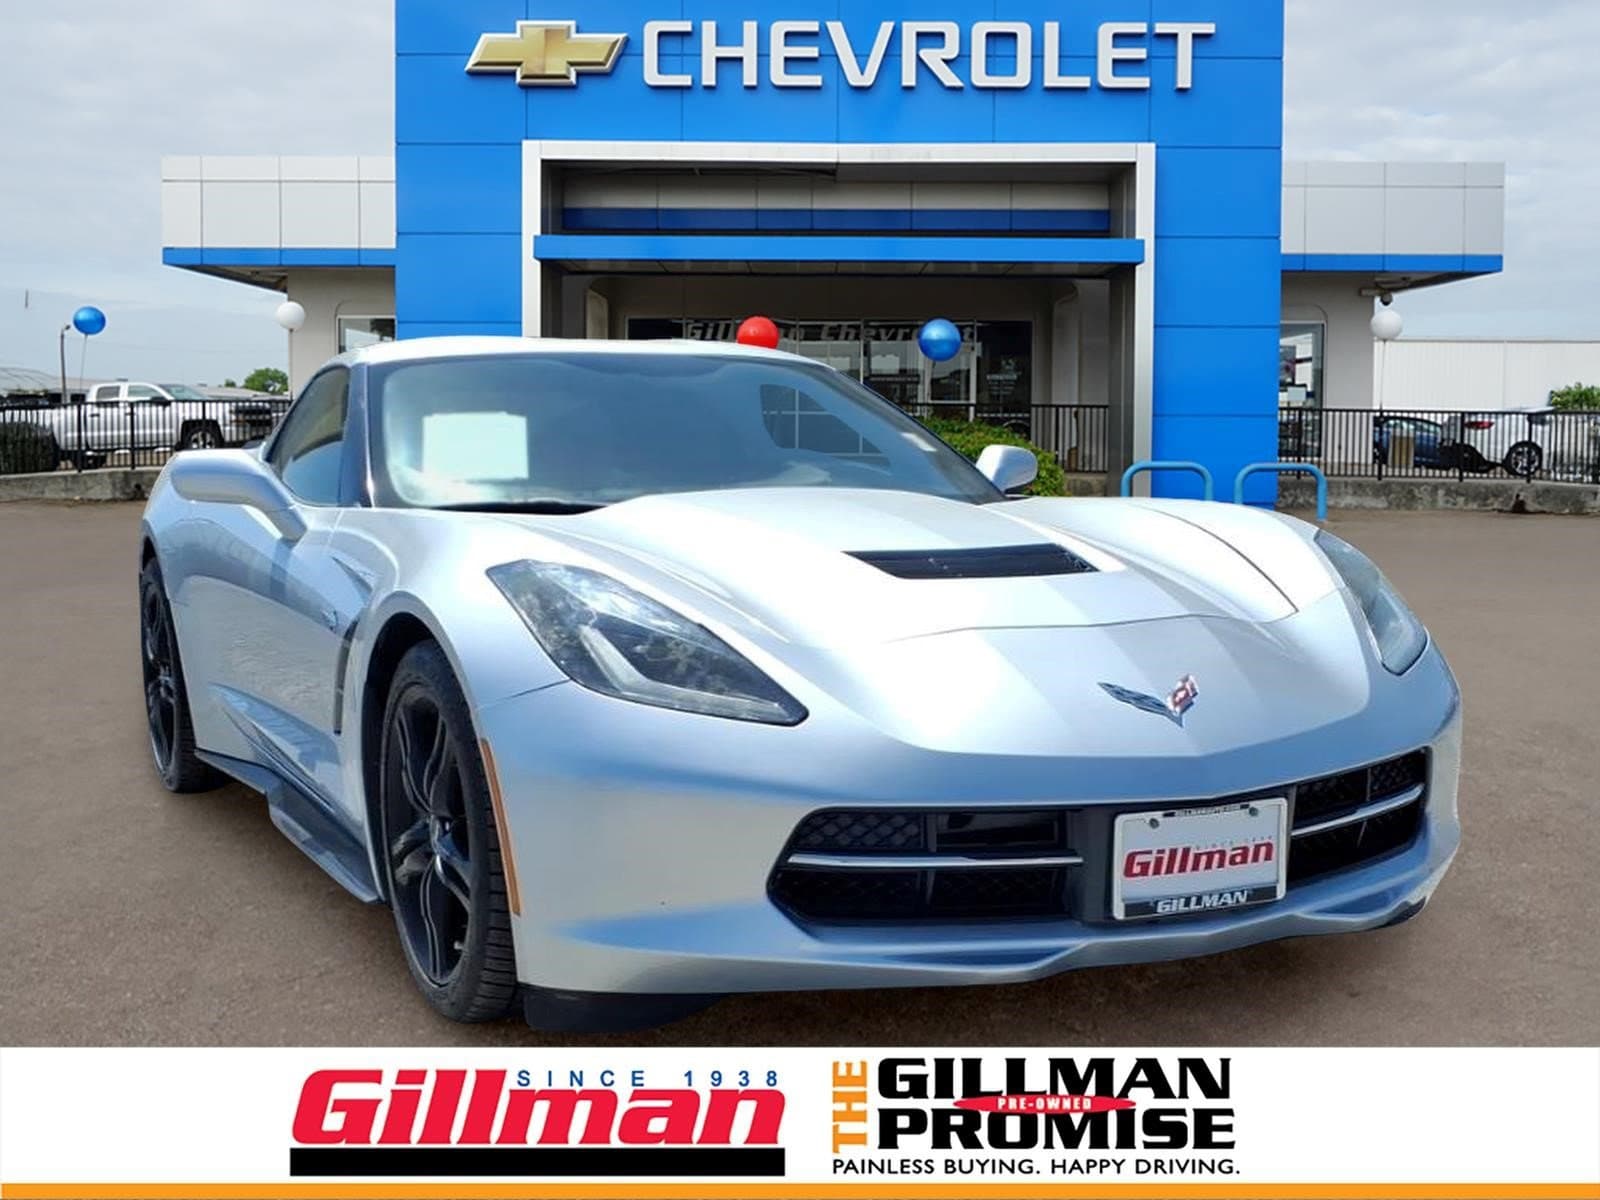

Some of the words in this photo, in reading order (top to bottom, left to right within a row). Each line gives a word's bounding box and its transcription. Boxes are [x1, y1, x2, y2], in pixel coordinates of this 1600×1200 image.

[643, 20, 1216, 90] CHEVROLET
[687, 322, 805, 343] Gilln
[819, 323, 974, 342] Chevrt
[1122, 841, 1274, 878] Gillman
[1156, 889, 1248, 914] GILLMAN
